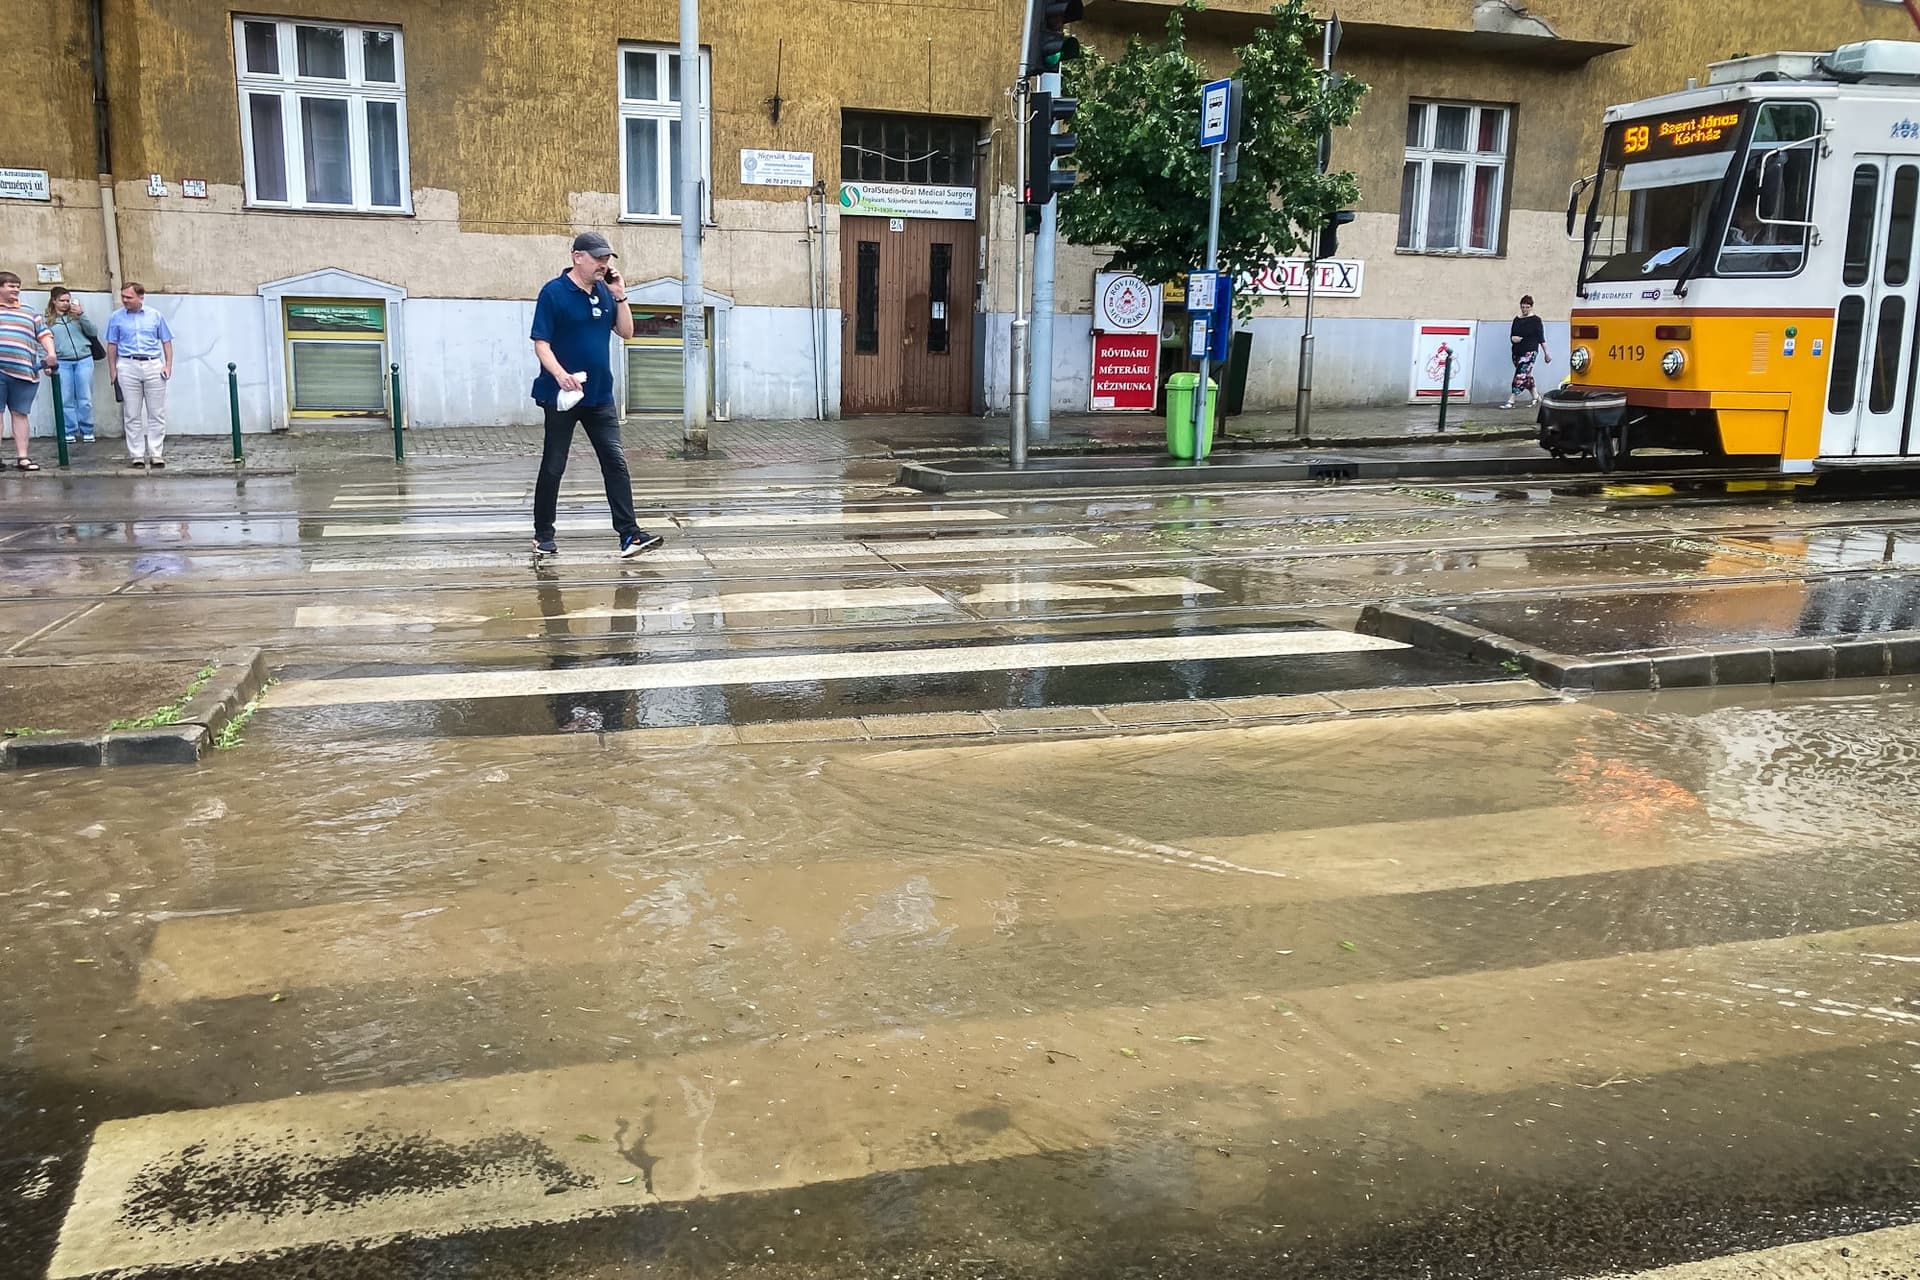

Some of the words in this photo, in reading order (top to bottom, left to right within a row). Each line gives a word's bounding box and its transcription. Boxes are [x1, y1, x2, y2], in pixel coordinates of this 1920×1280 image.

[1659, 119, 1696, 136] Szent
[1698, 114, 1738, 129] János
[1624, 126, 1649, 153] 59
[1674, 128, 1721, 145] Kórház
[34, 181, 43, 191] út
[862, 185, 916, 196] OralStudio-Oral
[918, 188, 945, 197] Medical
[947, 190, 973, 199] Surgery
[1601, 292, 1633, 300] BUDAPEST
[1608, 344, 1645, 361] 4119
[1098, 363, 1150, 375] MÉTERÁRU
[1096, 380, 1152, 391] KÉZIMUNKA
